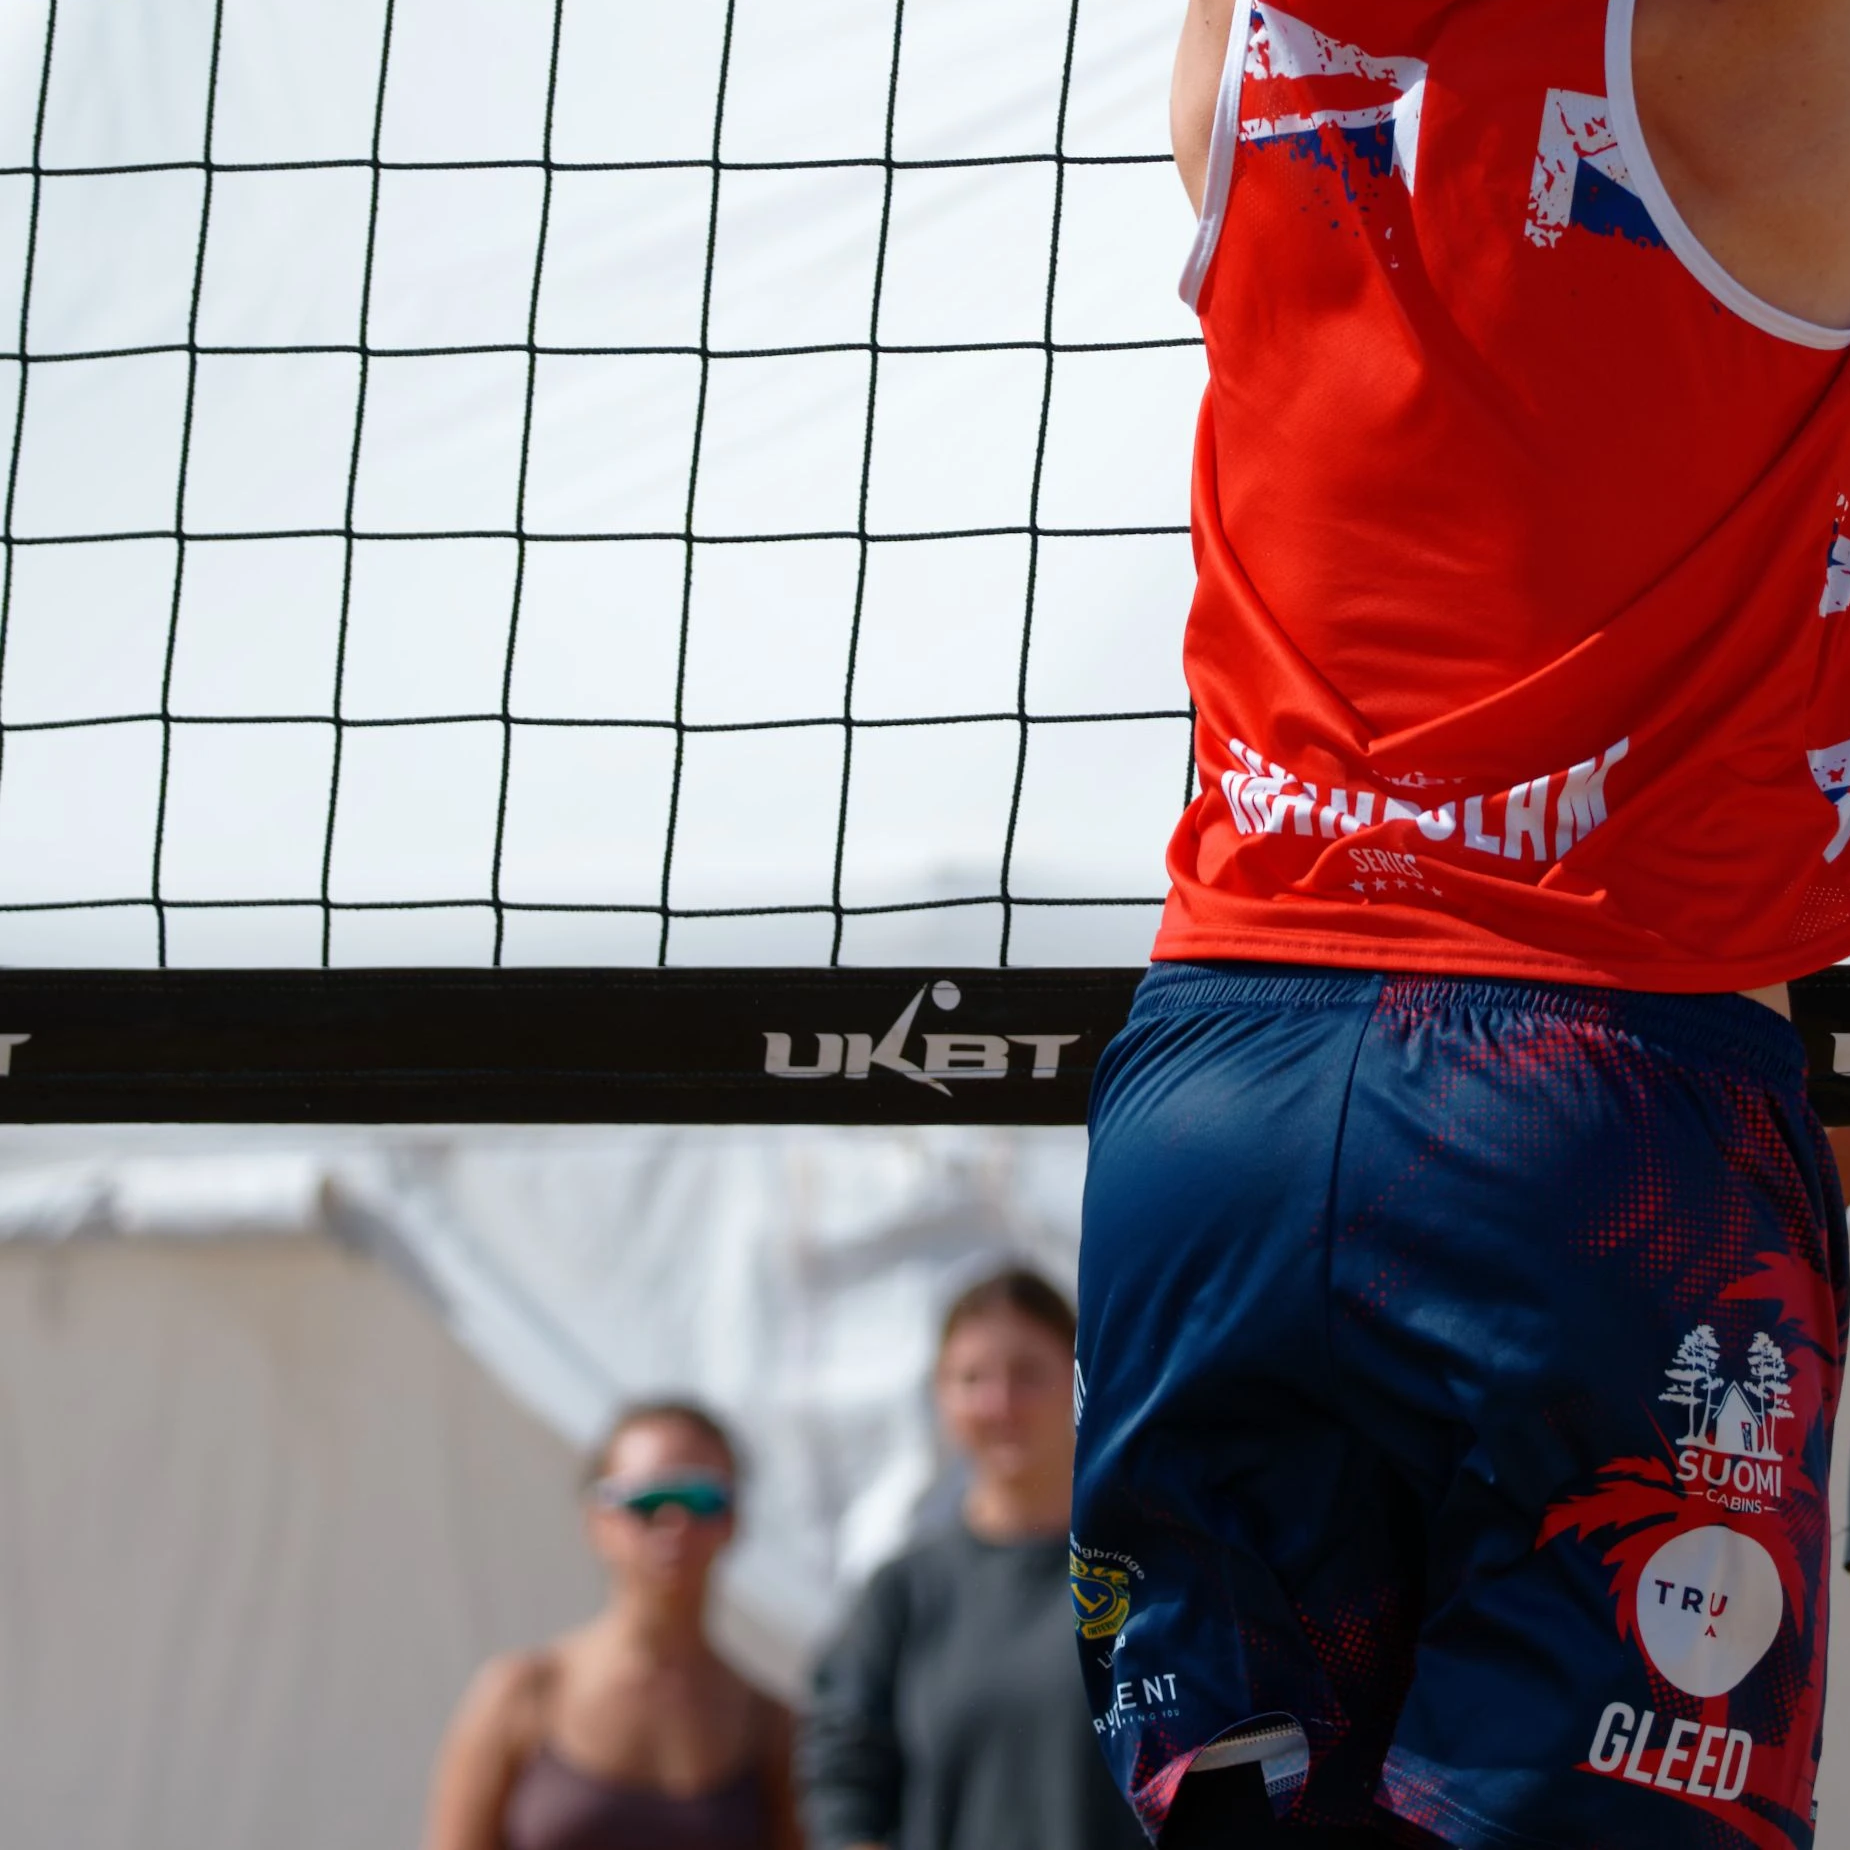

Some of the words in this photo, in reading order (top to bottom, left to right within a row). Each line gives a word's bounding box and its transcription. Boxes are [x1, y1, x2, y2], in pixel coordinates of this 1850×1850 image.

[1348, 848, 1424, 880] SERIES
[762, 982, 1081, 1097] UKBT
[1675, 1449, 1782, 1498] SUOMI
[1706, 1488, 1762, 1514] CABINS
[1654, 1579, 1729, 1618] TRU
[1588, 1701, 1753, 1801] GLEED
